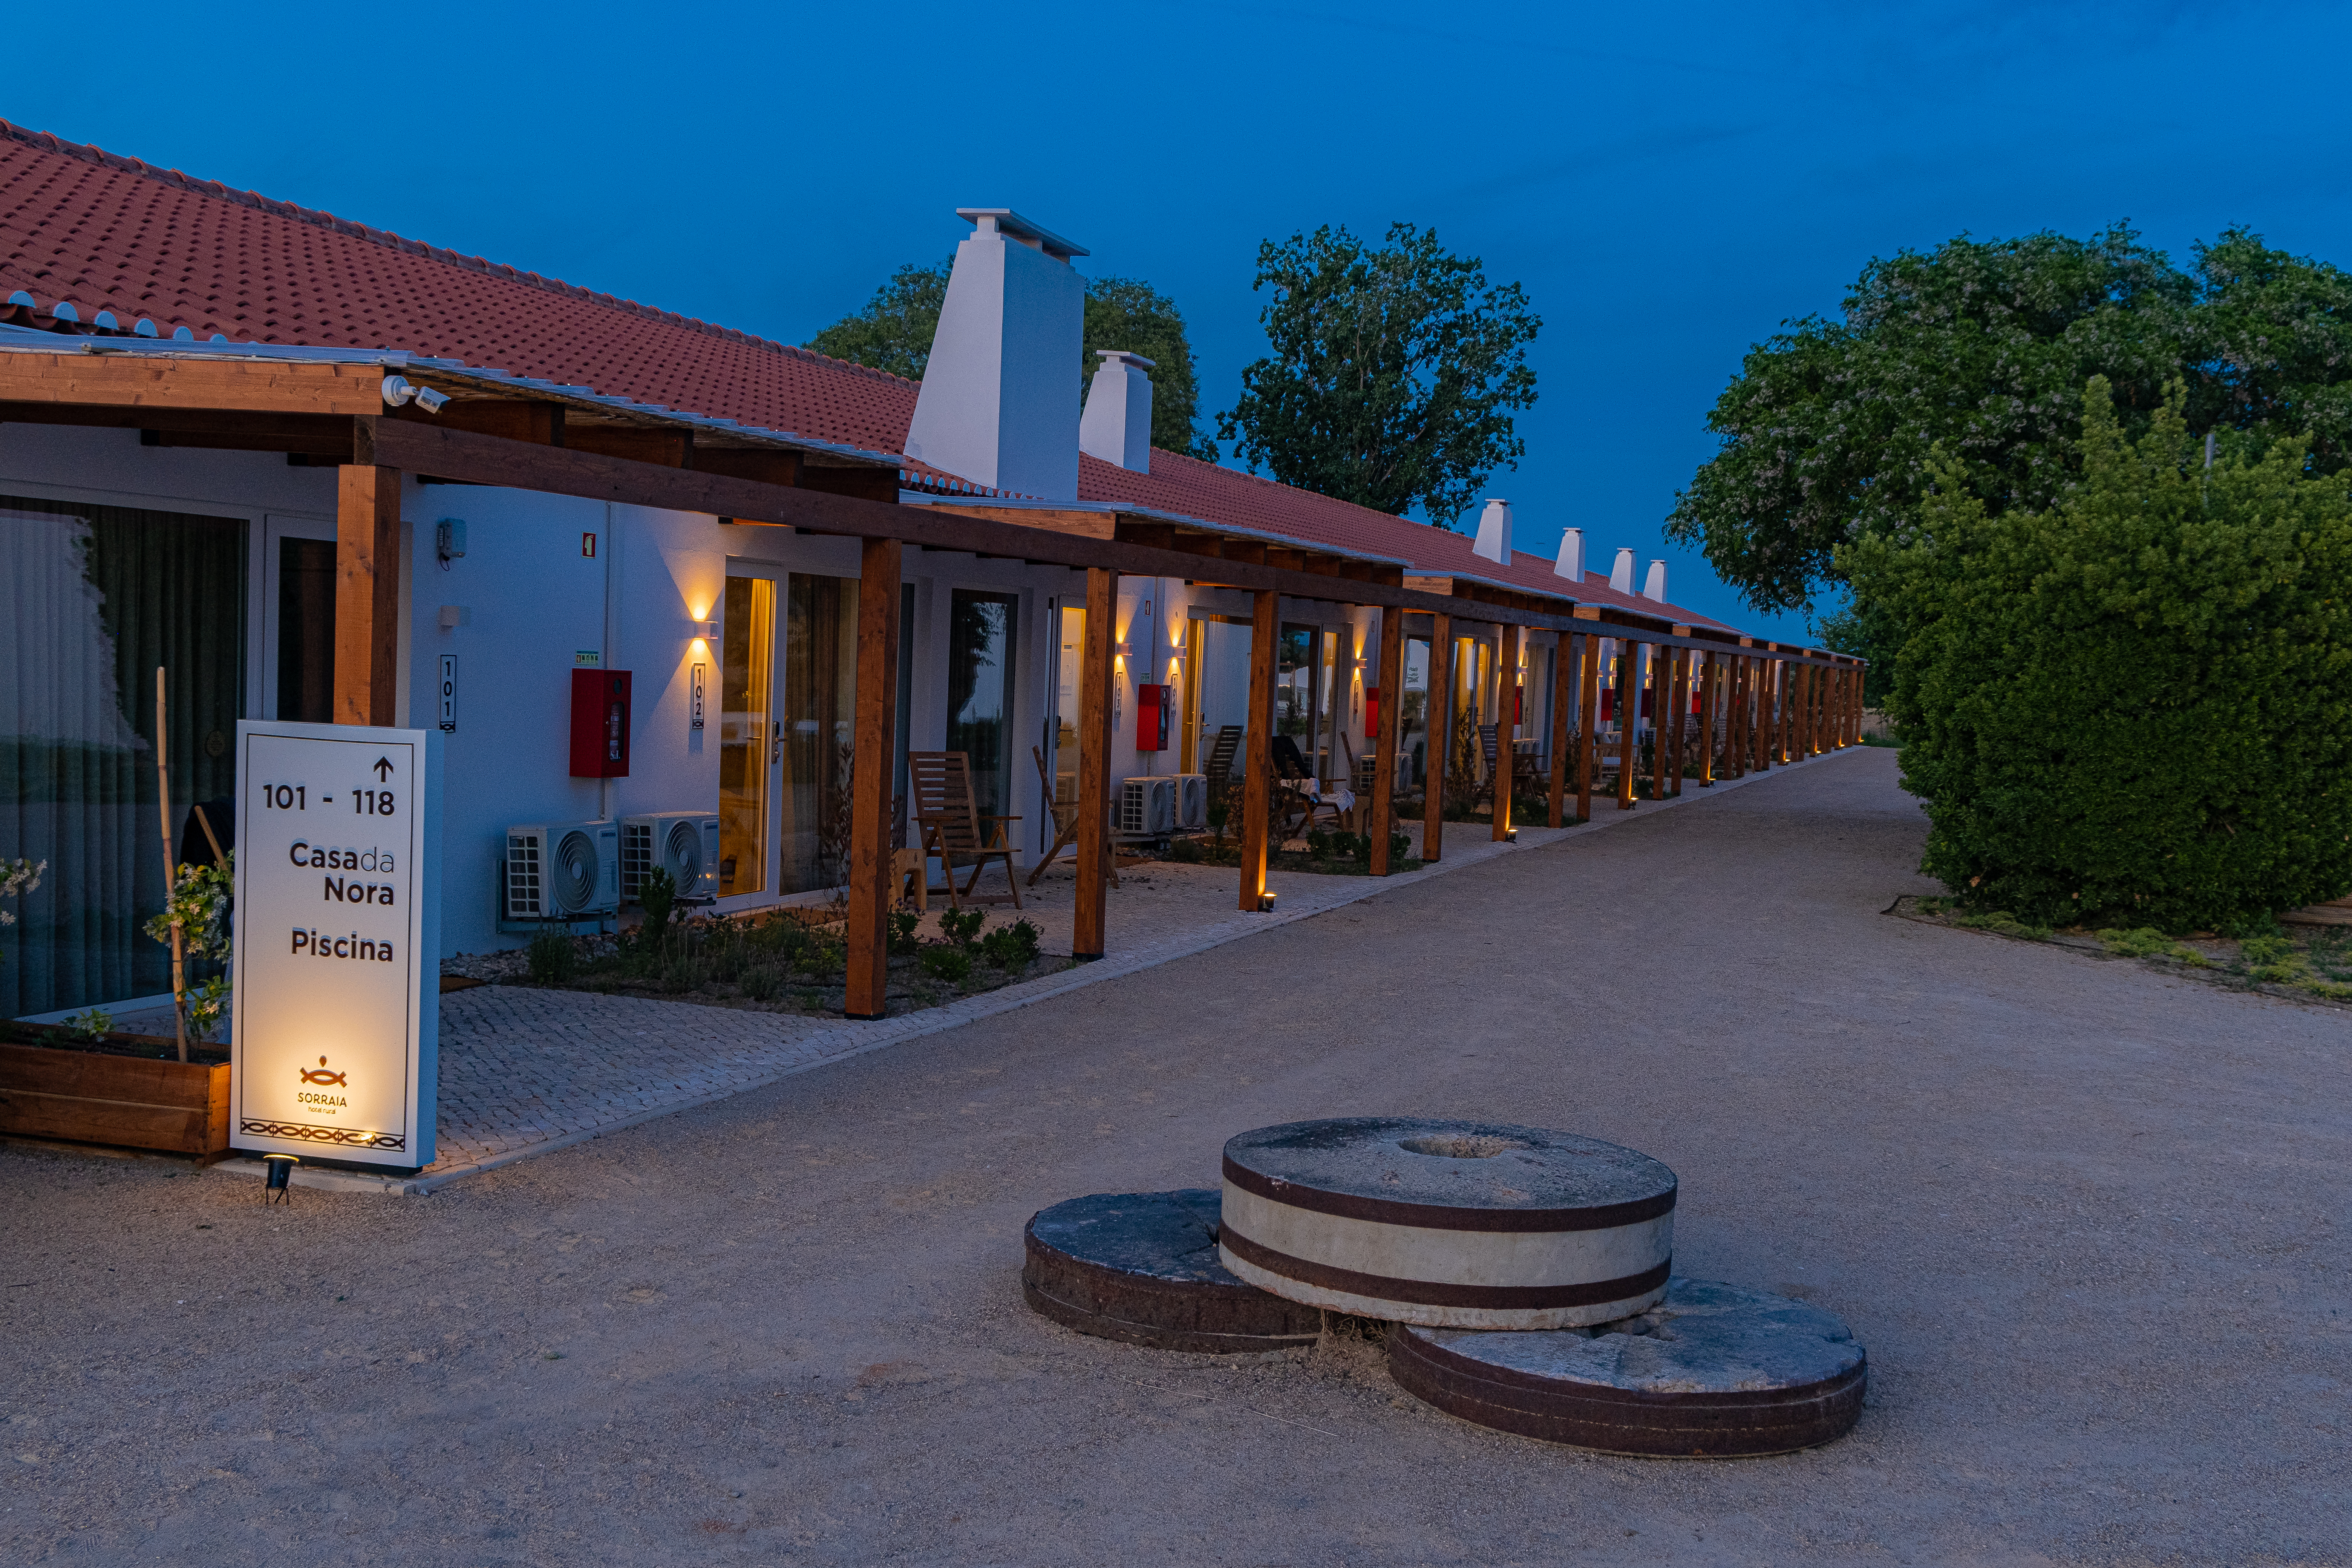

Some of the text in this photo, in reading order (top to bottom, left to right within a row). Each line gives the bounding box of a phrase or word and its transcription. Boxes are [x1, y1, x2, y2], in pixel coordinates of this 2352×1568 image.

[444, 661, 452, 716] 101
[263, 784, 306, 811] 101
[352, 789, 395, 816] 118
[324, 876, 394, 906] Nora
[291, 929, 393, 962] Piscina
[297, 1092, 347, 1107] SORRAIA
